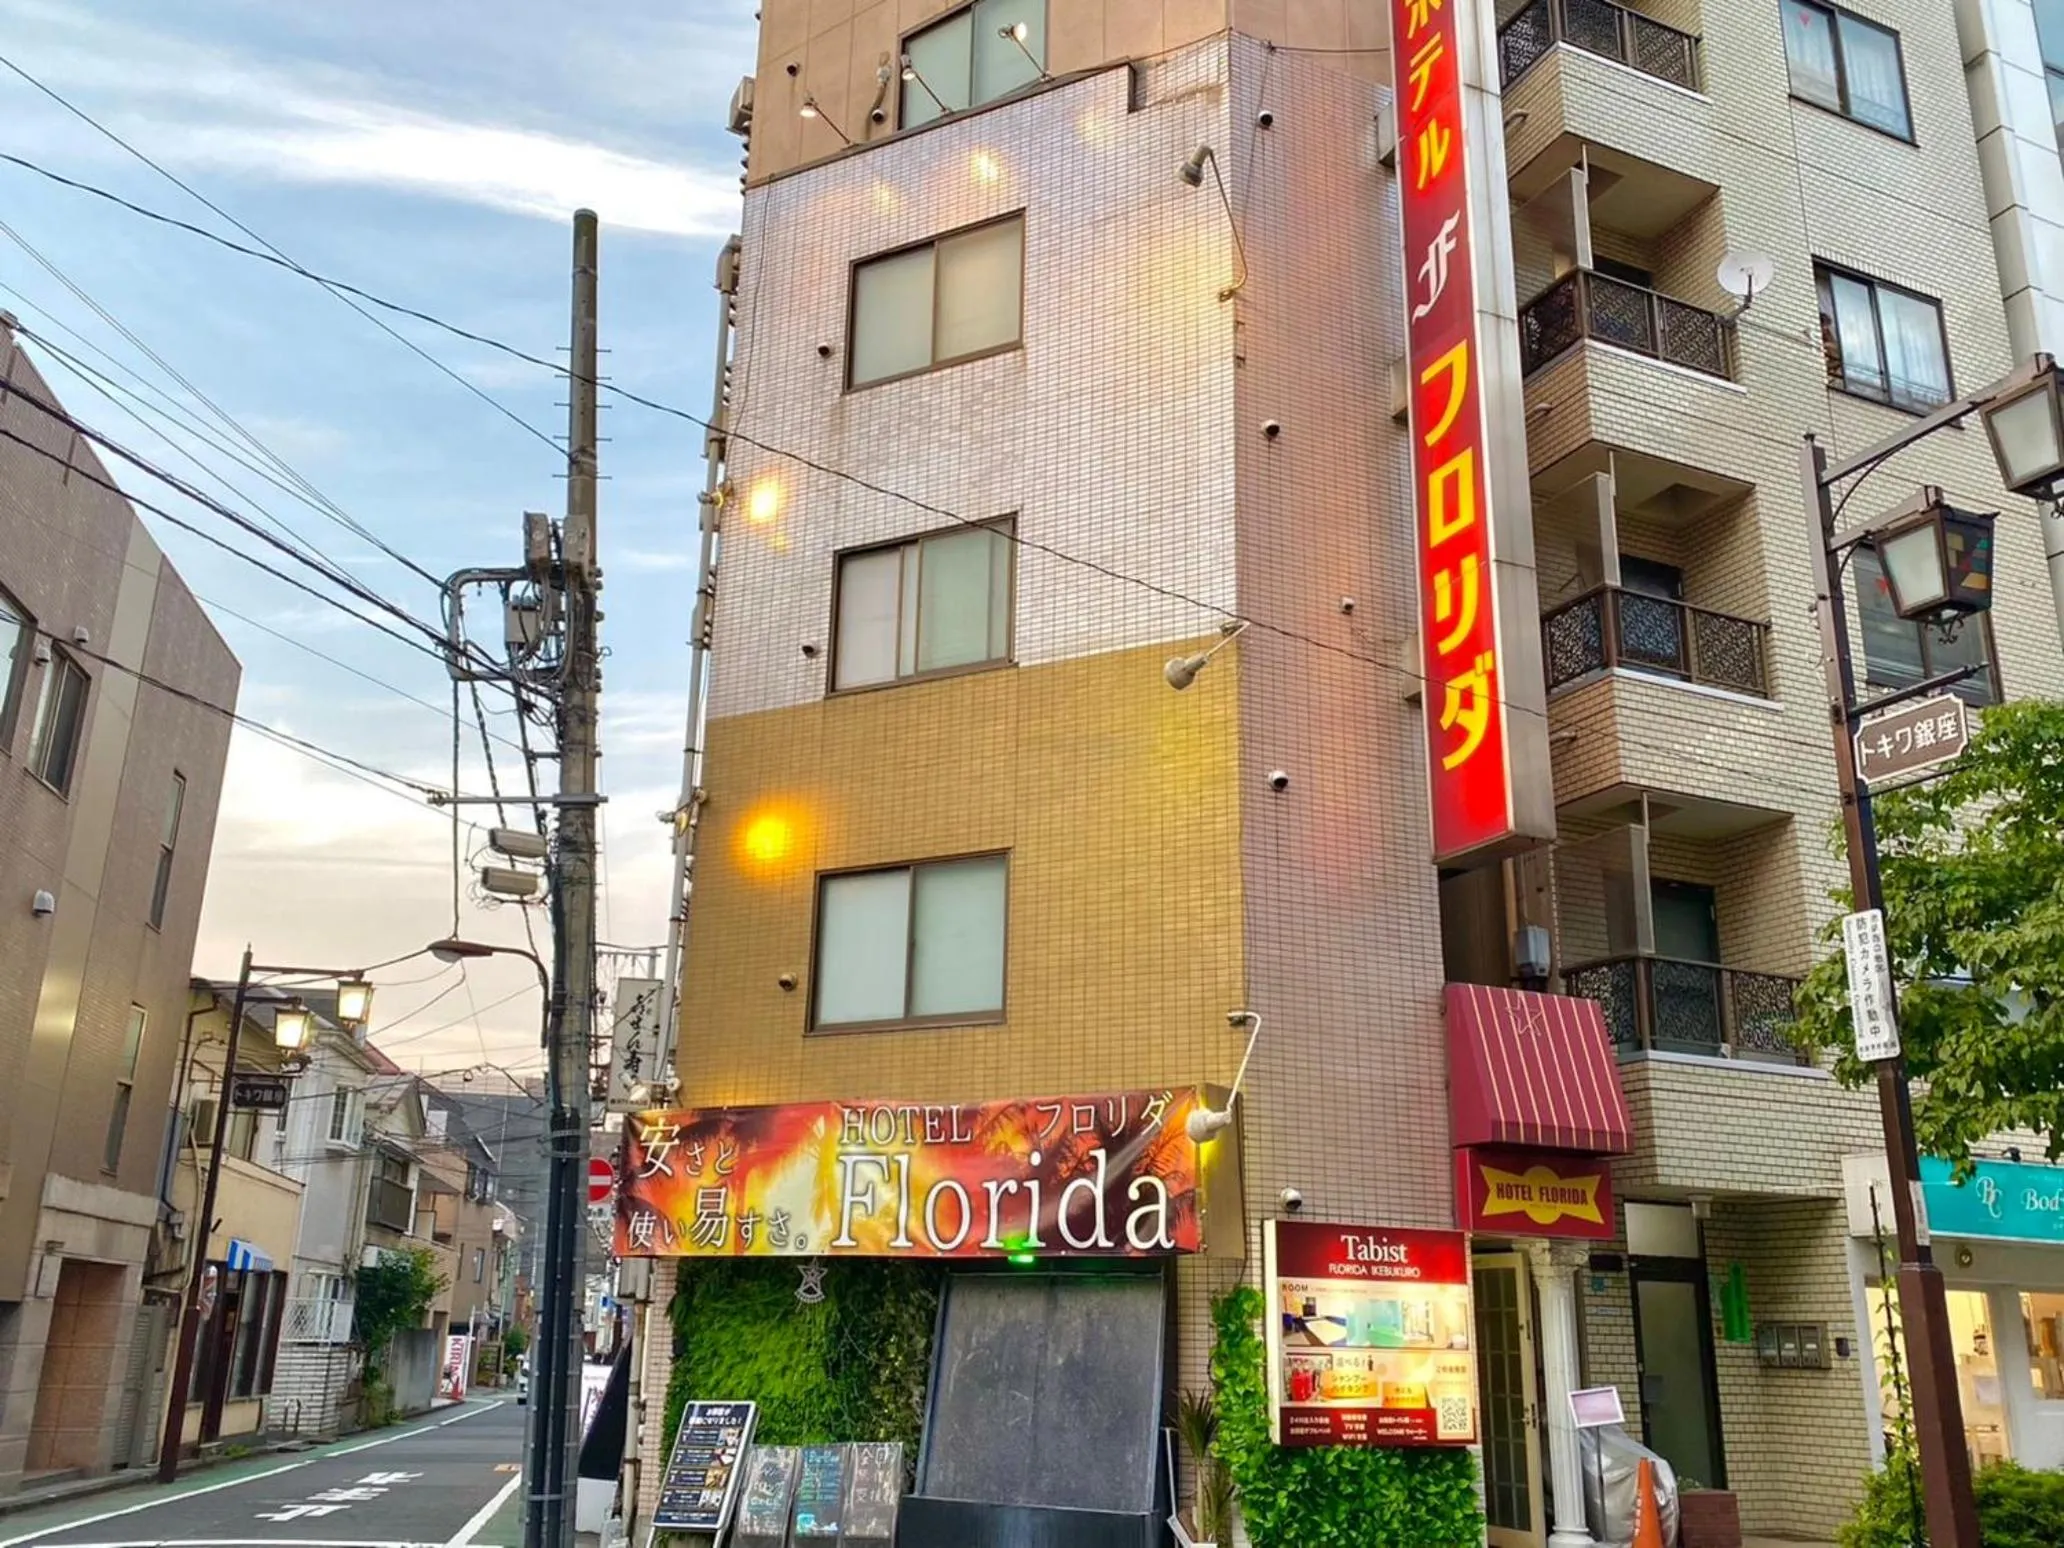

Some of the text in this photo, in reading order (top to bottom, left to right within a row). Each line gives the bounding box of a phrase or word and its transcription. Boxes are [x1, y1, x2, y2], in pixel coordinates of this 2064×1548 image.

[1421, 339, 1493, 771] フロリダ
[1860, 712, 1959, 767] トキワ銀座
[1855, 915, 1881, 1038] 防犯カメラ作動中
[841, 1105, 972, 1145] HOTEL
[1035, 1091, 1174, 1138] フロリダ
[638, 1121, 739, 1179] 安さと
[831, 1149, 1175, 1252] Florida
[1496, 1182, 1588, 1206] HOTEL FLORIDA
[2020, 1187, 2064, 1212] Bod
[627, 1186, 808, 1250] 使い易すさ。
[1329, 1263, 1421, 1278] FLORIDA IKEBUKURO
[1340, 1235, 1408, 1263] Tabist
[1281, 1284, 1308, 1292] ROOM
[449, 1337, 464, 1374] KIRIN
